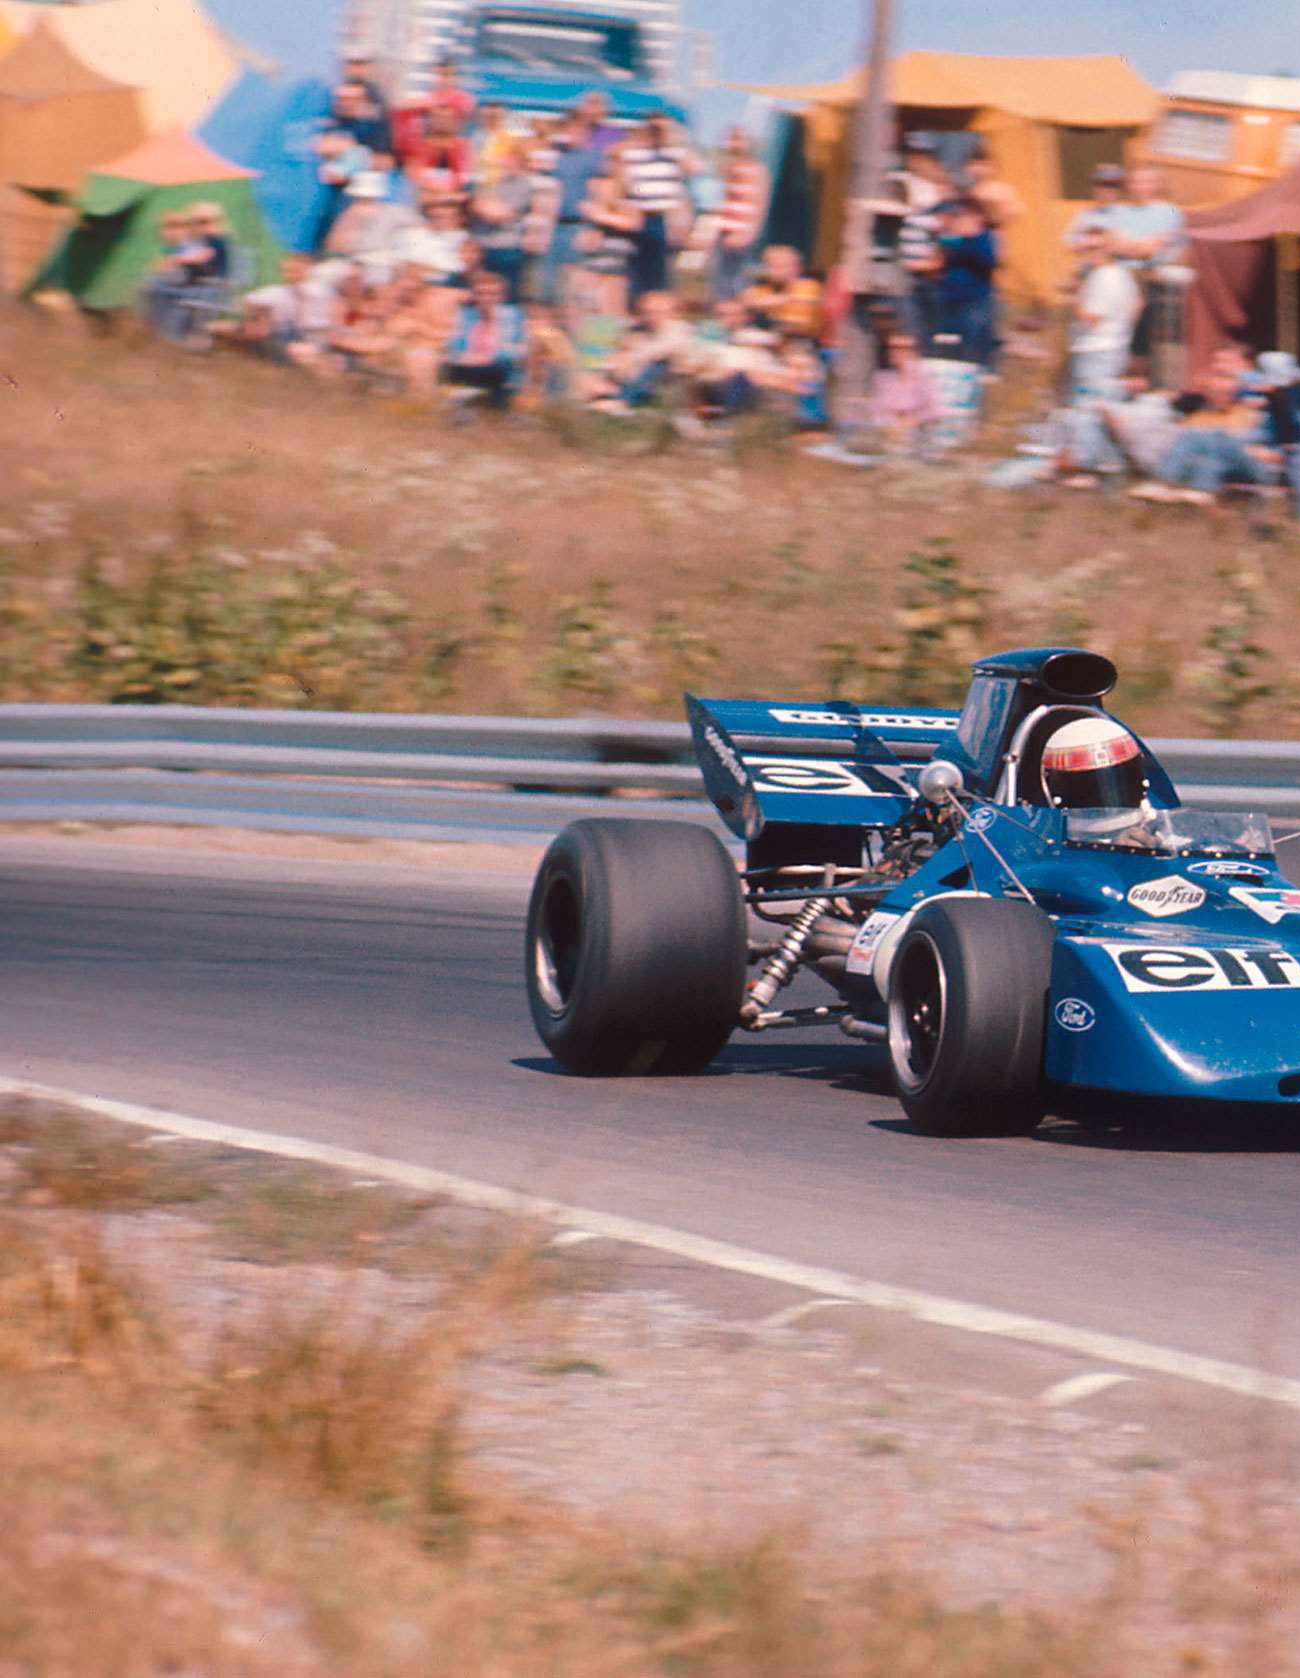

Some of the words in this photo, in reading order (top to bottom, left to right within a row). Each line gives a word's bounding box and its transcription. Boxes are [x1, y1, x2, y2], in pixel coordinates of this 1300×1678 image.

[1130, 887, 1203, 904] GOODYEAR
[1118, 949, 1293, 988] elf
[1062, 1002, 1087, 1026] Ford
